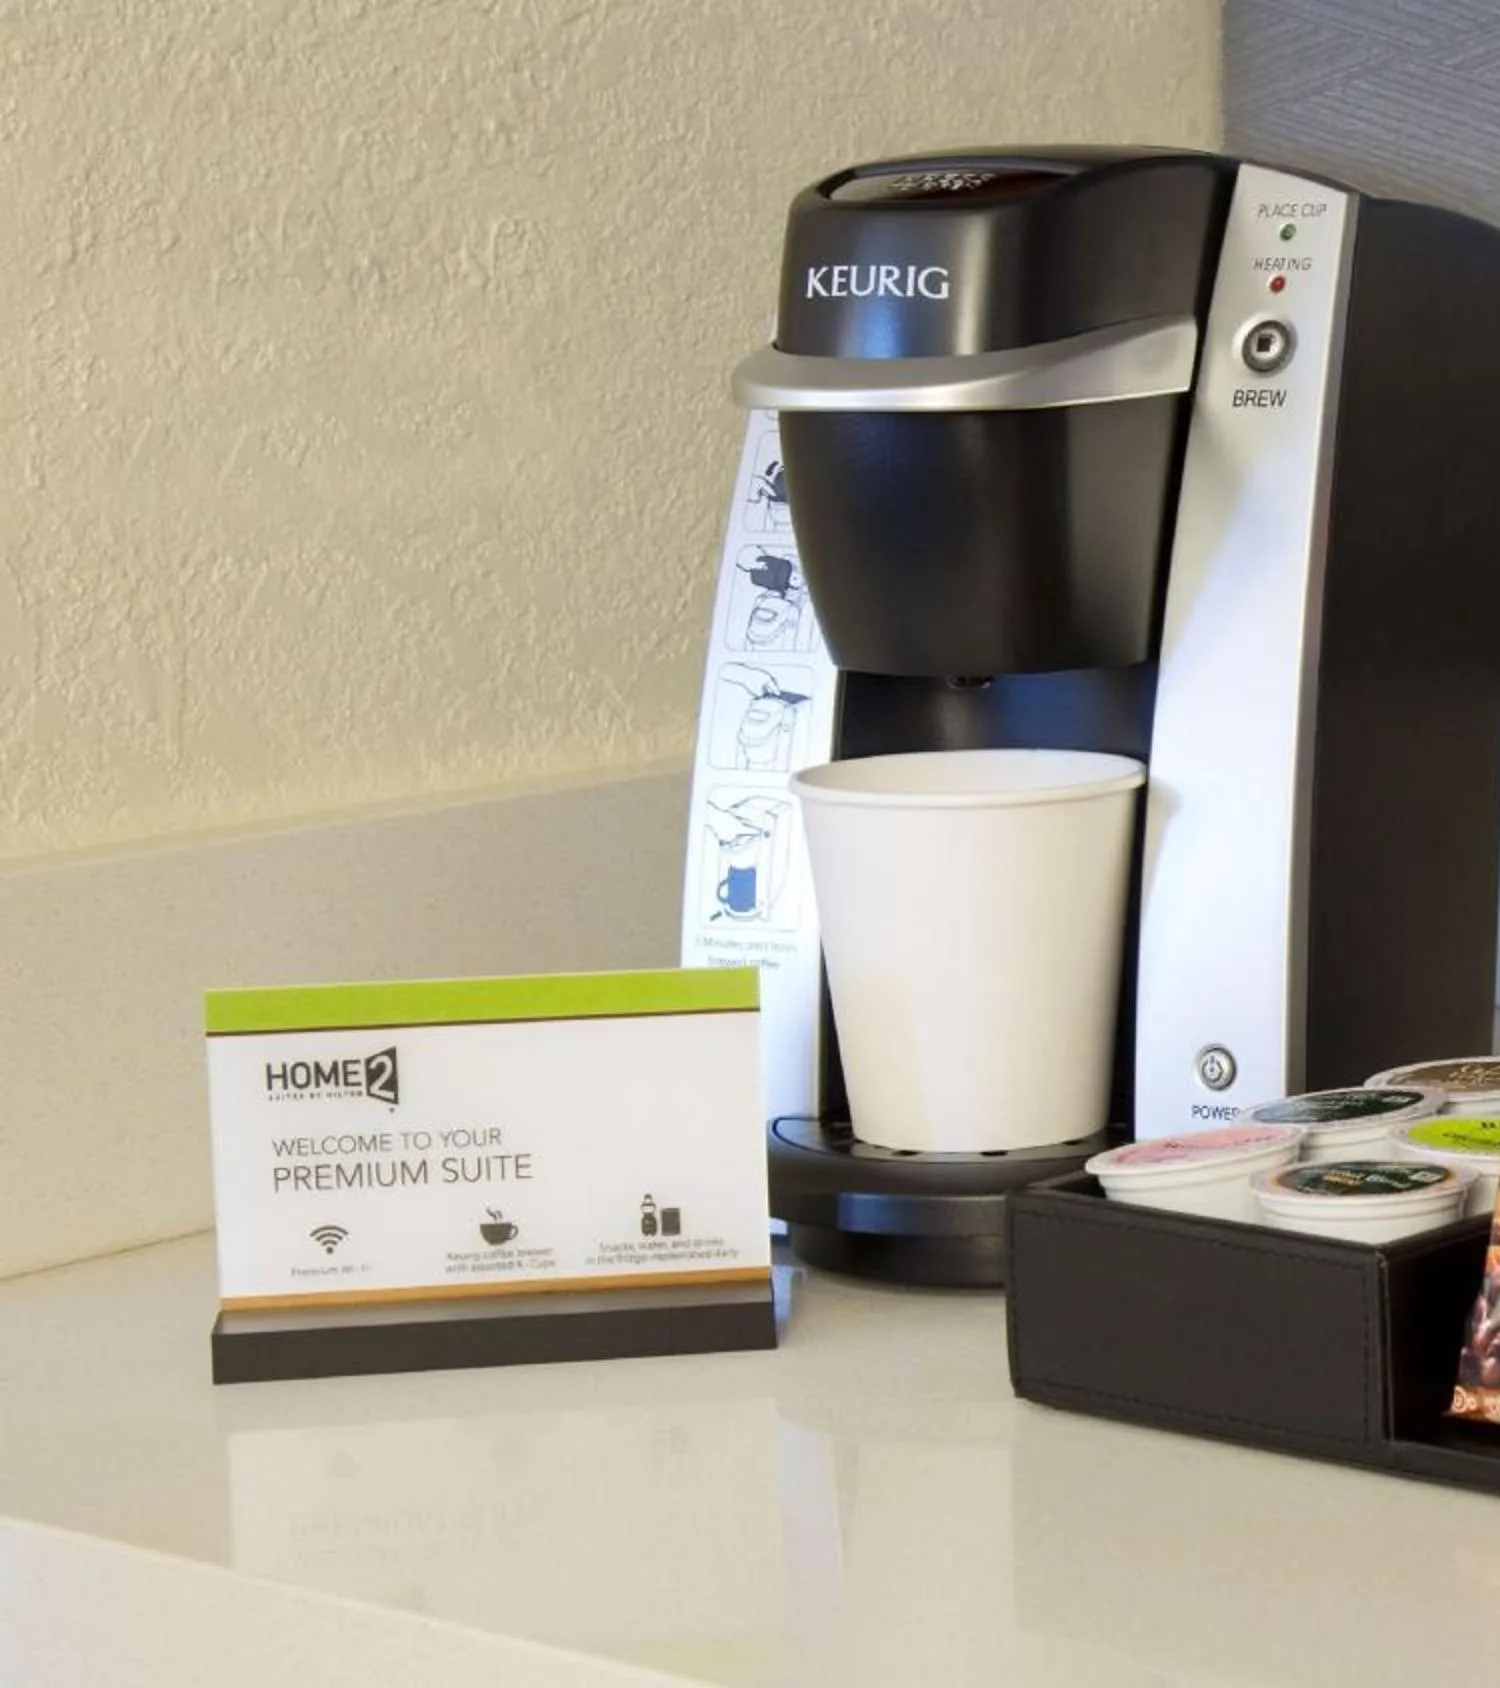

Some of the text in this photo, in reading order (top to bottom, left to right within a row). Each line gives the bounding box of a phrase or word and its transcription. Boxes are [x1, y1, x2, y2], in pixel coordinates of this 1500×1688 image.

[1300, 202, 1328, 218] CUP
[1252, 256, 1313, 272] HEATING
[805, 264, 951, 300] KEURIG
[1232, 389, 1288, 409] BREW
[272, 1126, 502, 1158] WELCOME TO YOUR
[273, 1153, 534, 1193] PREMIUM SUITE
